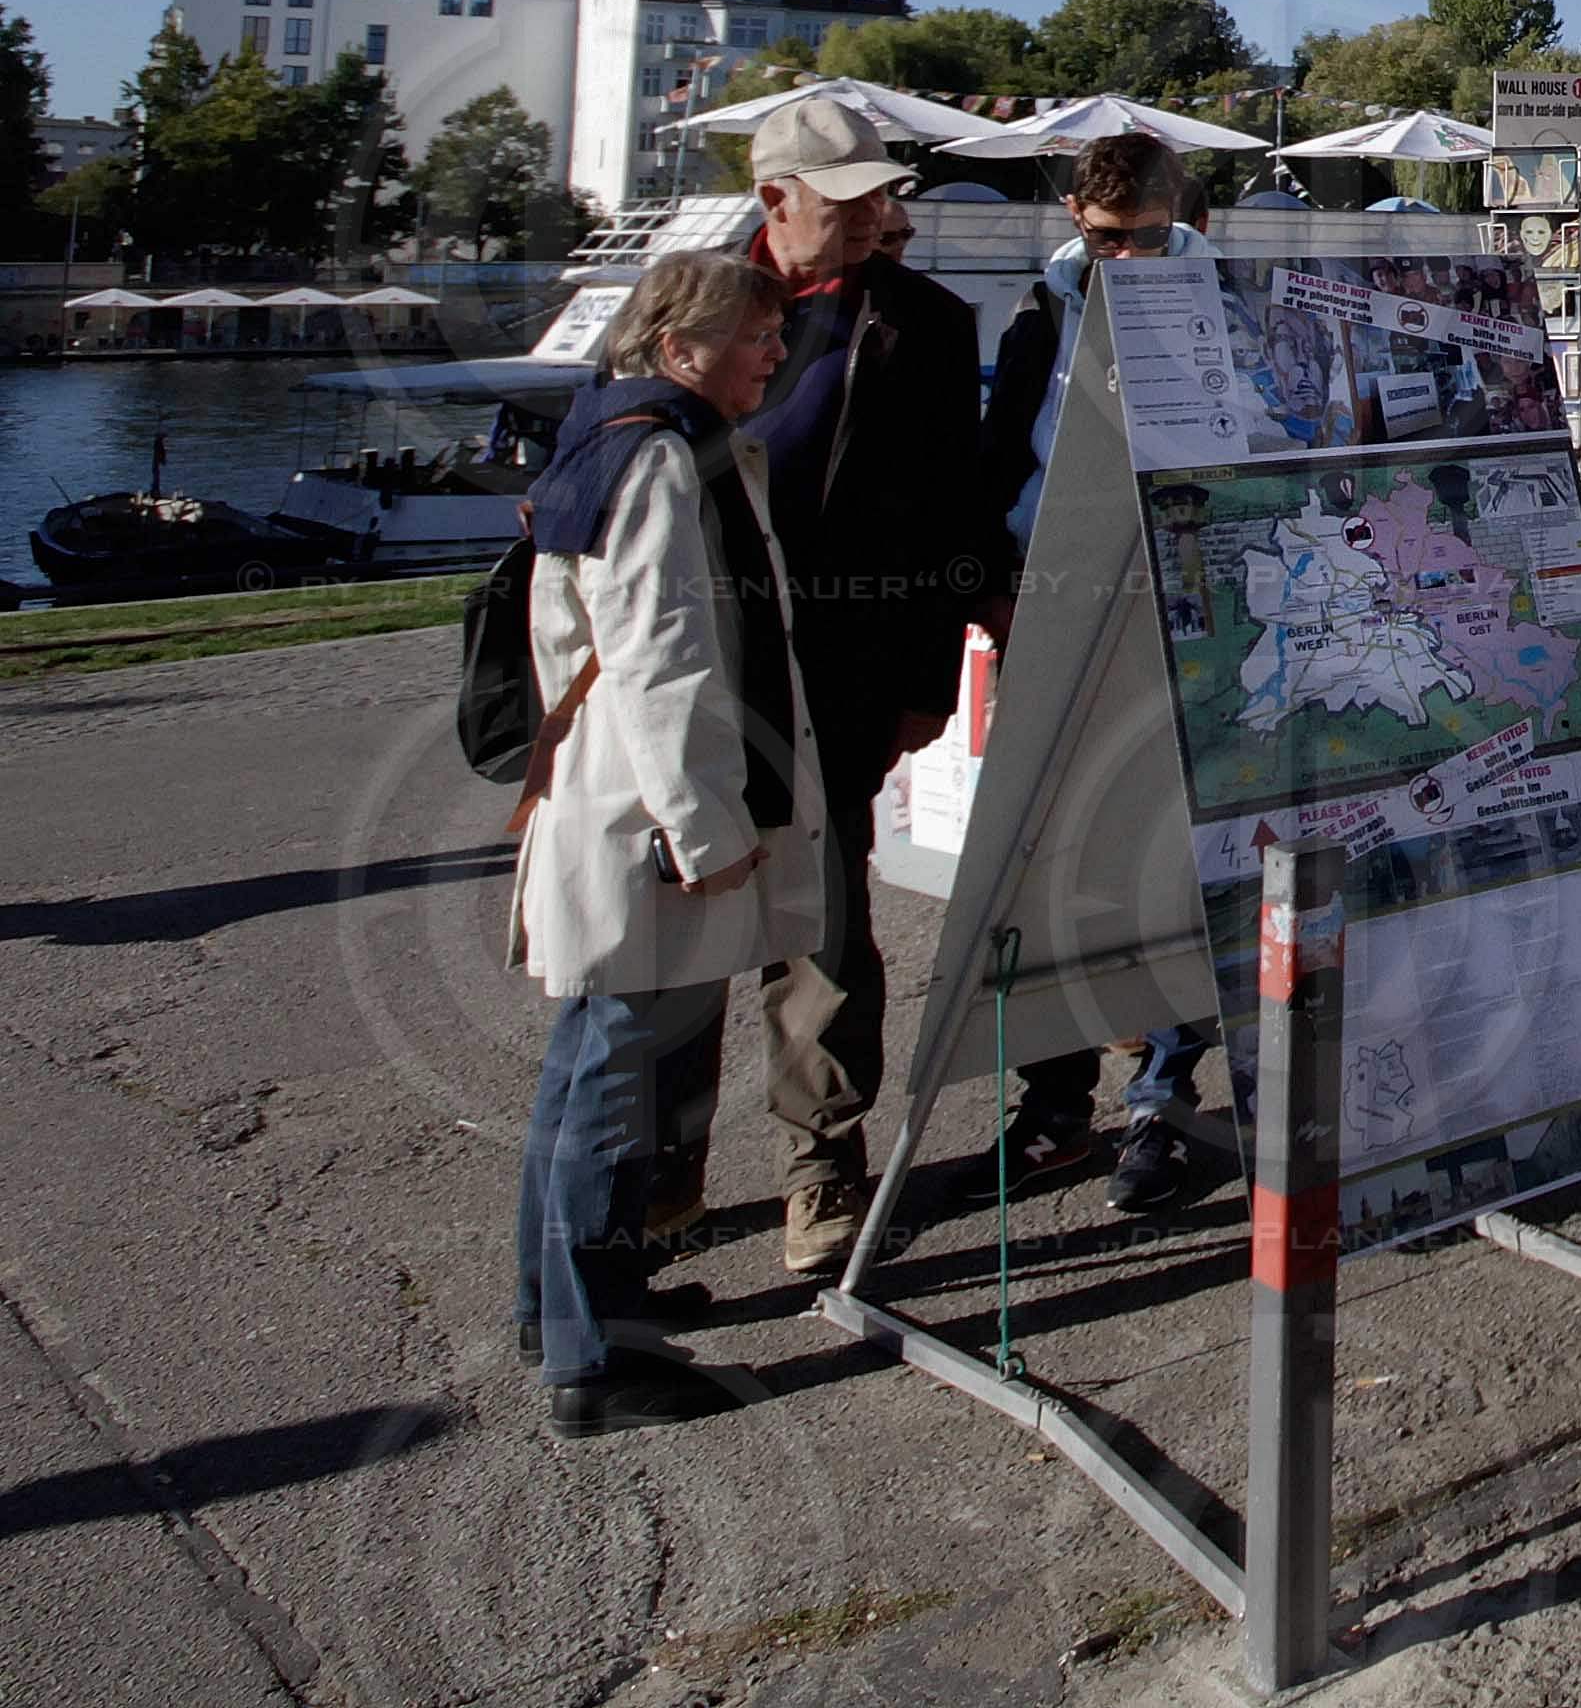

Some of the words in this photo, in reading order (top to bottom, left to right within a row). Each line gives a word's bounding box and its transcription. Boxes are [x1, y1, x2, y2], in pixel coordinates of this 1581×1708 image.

[1497, 79, 1528, 96] WALL
[1531, 80, 1568, 96] HOUSE
[1523, 103, 1535, 117] the
[1536, 104, 1566, 117] east-side
[1287, 272, 1329, 291] PLEASE
[1309, 288, 1371, 312] photograph
[1332, 306, 1348, 318] for
[1460, 313, 1495, 329] KEINE
[1498, 322, 1524, 336] FOTOS
[1456, 610, 1499, 624] BERLIN
[1287, 623, 1335, 638] BERLIN
[1294, 637, 1331, 652] WEST
[1465, 739, 1497, 762] KEINE
[1497, 722, 1530, 745] FOTOS
[1519, 765, 1552, 780] FOTOS
[1477, 789, 1569, 817] Geschäftsbereich
[1298, 802, 1344, 824] PLEASE
